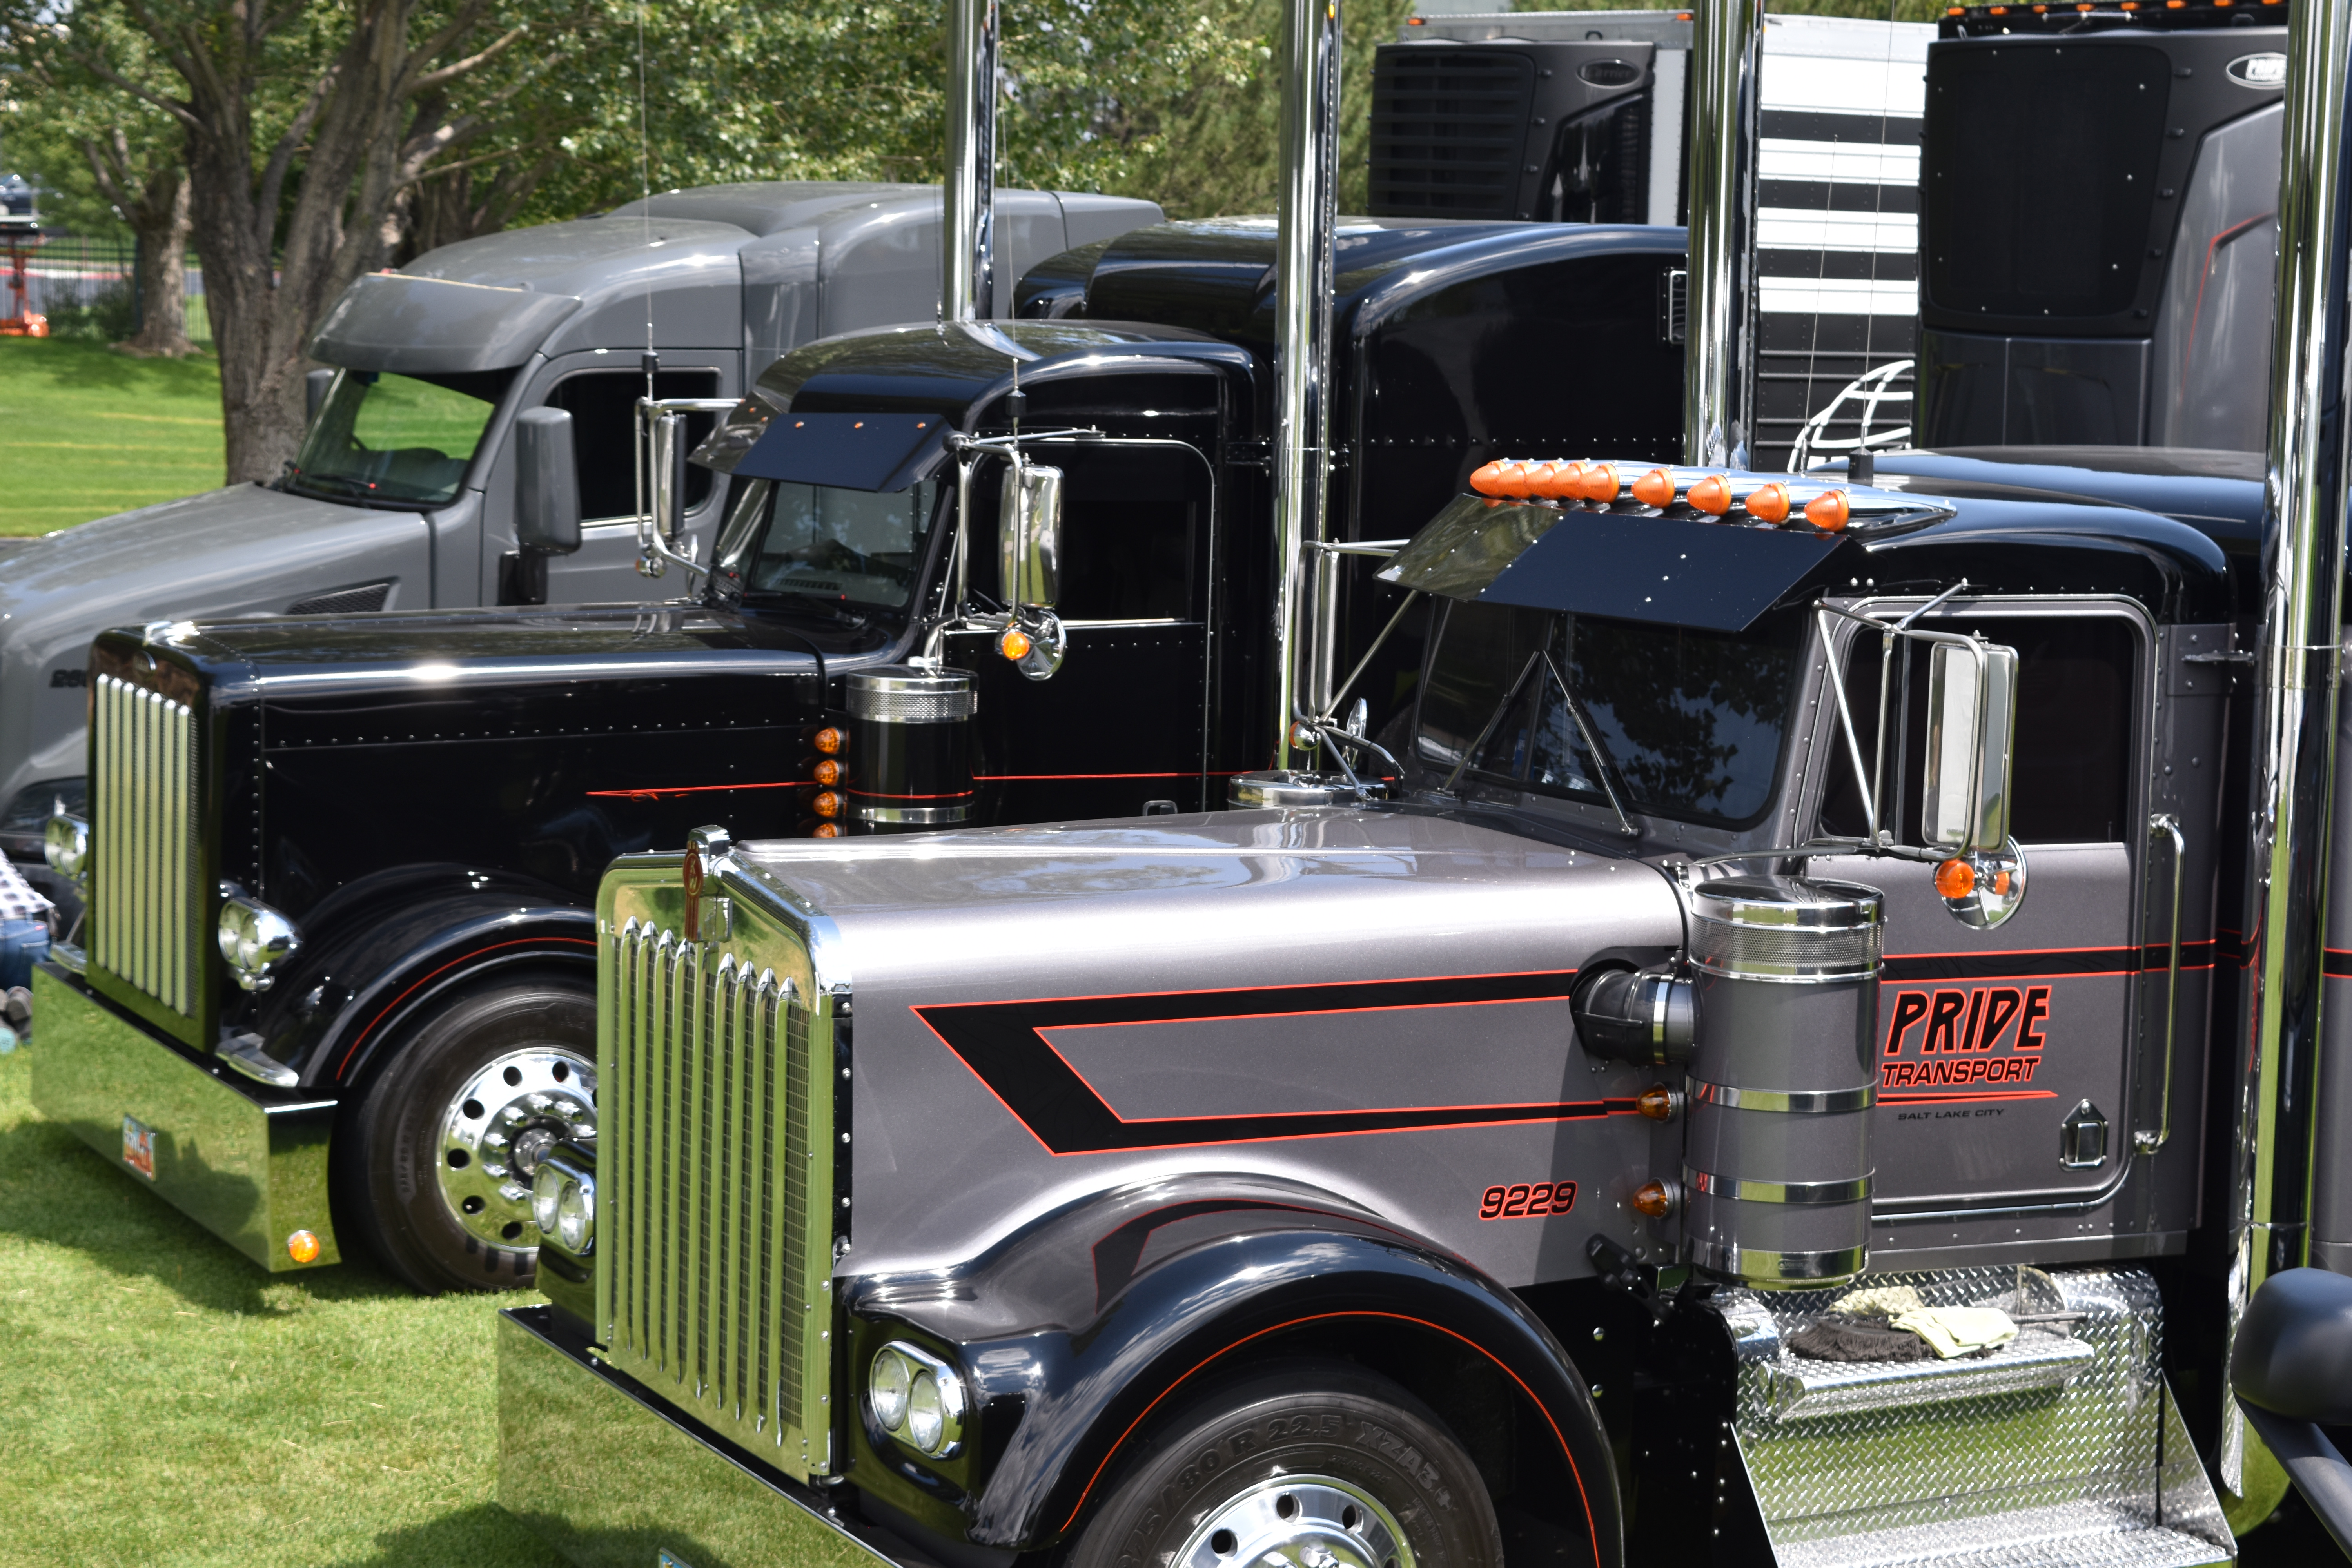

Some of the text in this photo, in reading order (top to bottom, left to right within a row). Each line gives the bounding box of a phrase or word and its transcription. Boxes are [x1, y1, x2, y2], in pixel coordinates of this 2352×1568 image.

[1884, 985, 2052, 1056] PRIDE
[1882, 1056, 2041, 1088] TRANSPORT
[1898, 1108, 2004, 1120] SALT LAKE CITY
[1479, 1180, 1578, 1221] 9229
[1268, 1414, 1342, 1443] 22.5
